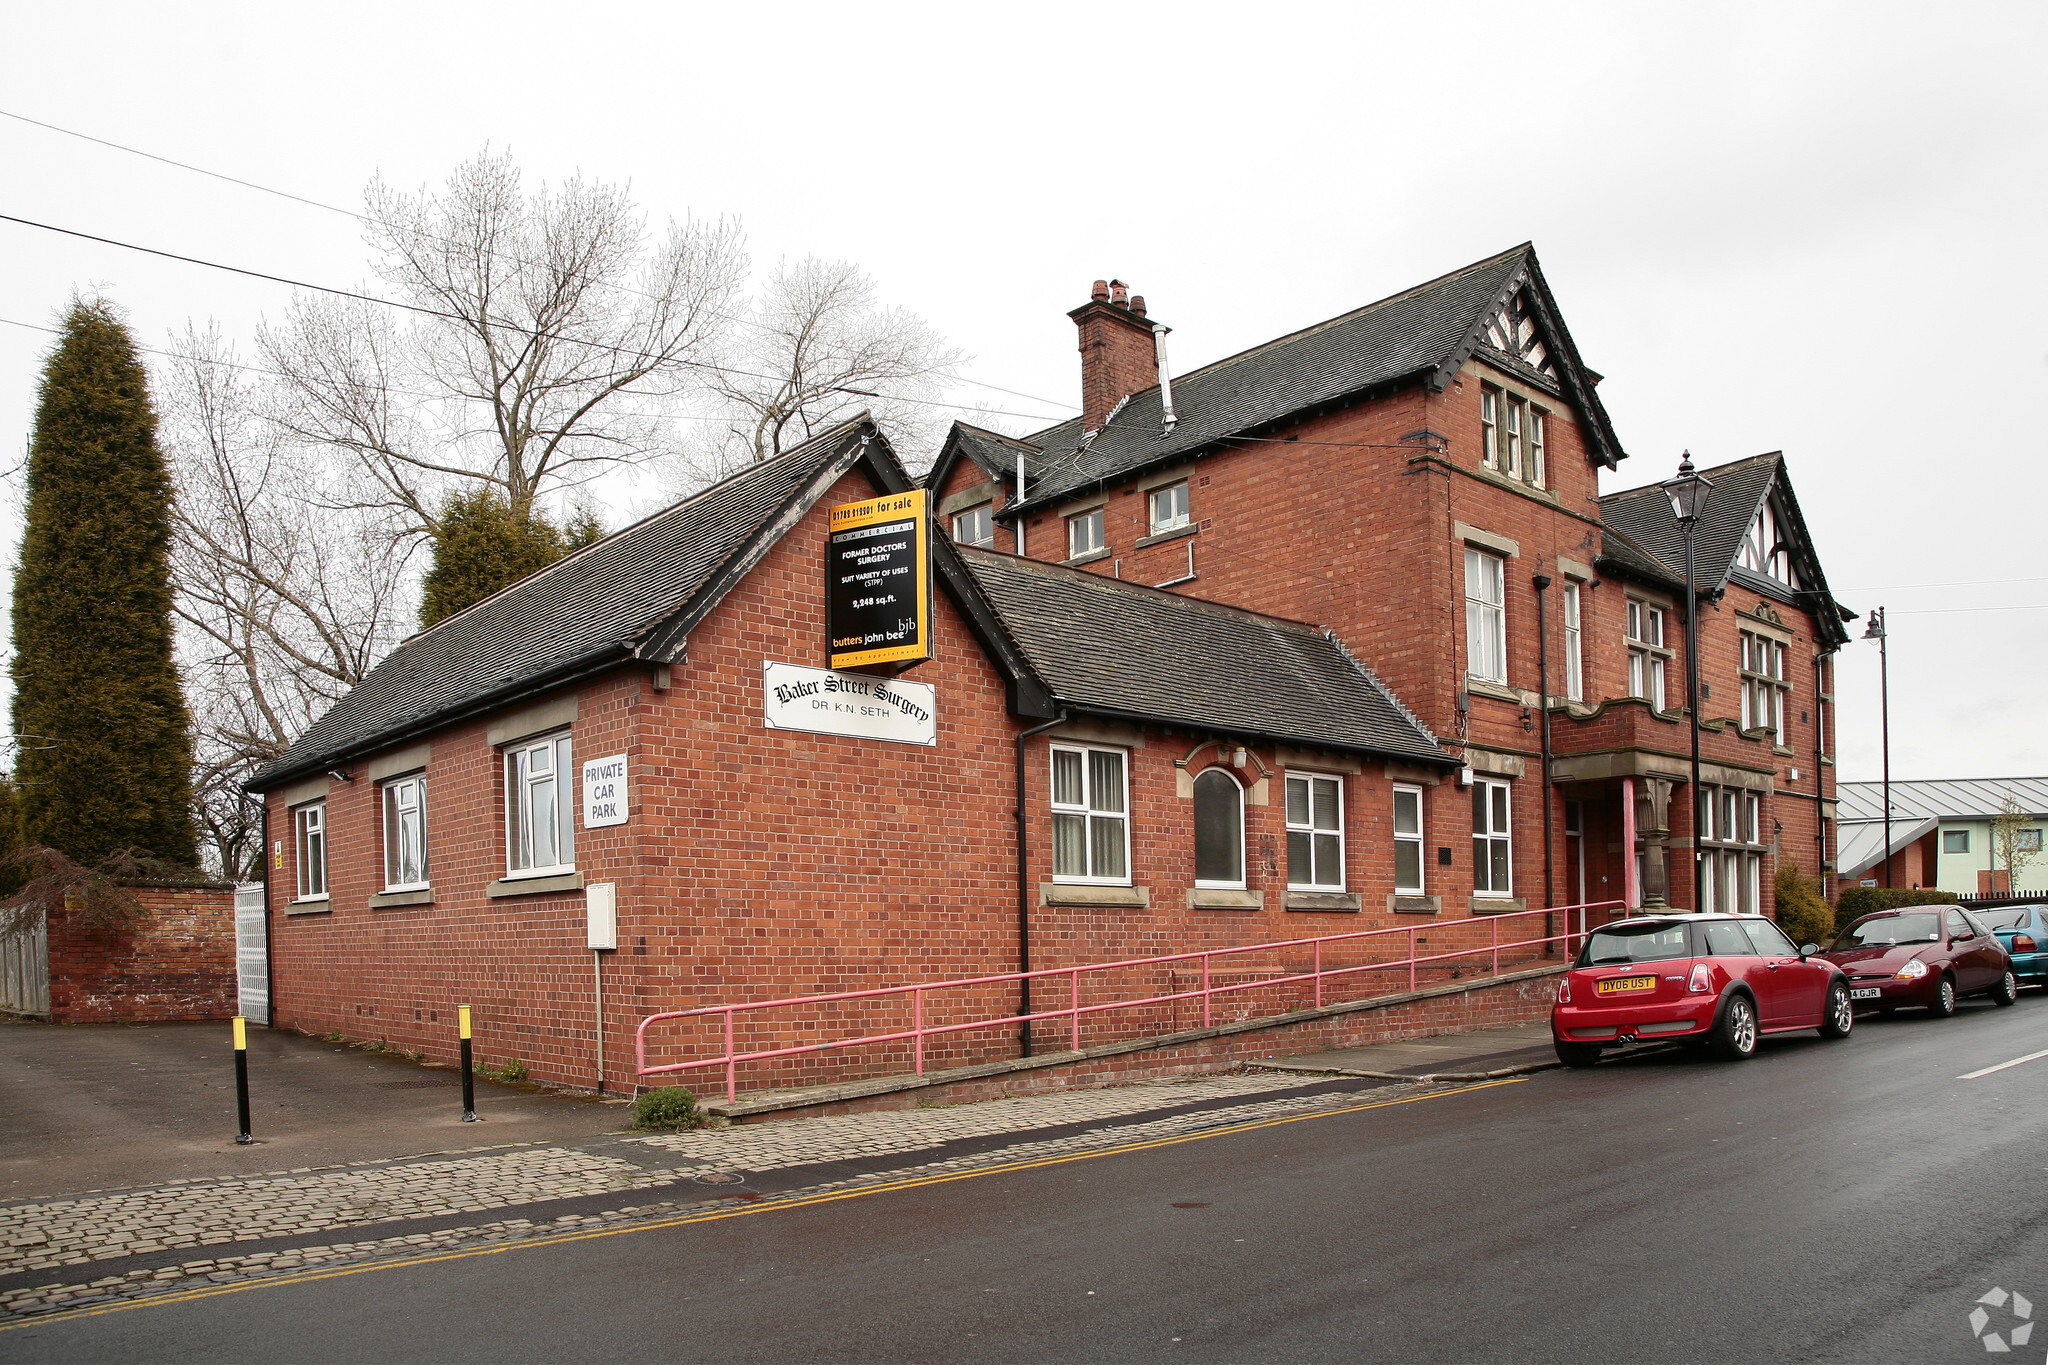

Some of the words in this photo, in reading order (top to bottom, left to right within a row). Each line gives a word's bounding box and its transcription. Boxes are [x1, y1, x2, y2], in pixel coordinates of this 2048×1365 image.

[877, 501, 890, 512] for
[893, 497, 912, 510] sale
[835, 524, 911, 542] COMMERCIAL
[842, 548, 870, 560] FORMER
[871, 541, 907, 554] DOCTORS
[857, 553, 891, 565] SURGERY
[841, 575, 854, 584] SUIT
[855, 571, 880, 581] VARIETY
[881, 569, 891, 577] OF
[892, 566, 909, 575] USES
[864, 578, 883, 588] (STPP)
[852, 597, 874, 609] 2,248
[898, 617, 916, 635] bjb
[832, 636, 863, 647] butters
[864, 632, 884, 645] john
[886, 631, 904, 640] bee
[774, 680, 819, 708] Baker
[824, 675, 870, 696] Street
[872, 682, 929, 725] Surgery
[812, 700, 831, 711] DR.
[860, 706, 890, 718] SETH
[586, 762, 623, 783] PRIVATE
[594, 784, 615, 800] CAR
[592, 802, 617, 820] PARK
[1603, 980, 1628, 991] DY06
[1631, 978, 1652, 988] UST
[1859, 989, 1877, 998] GJR
